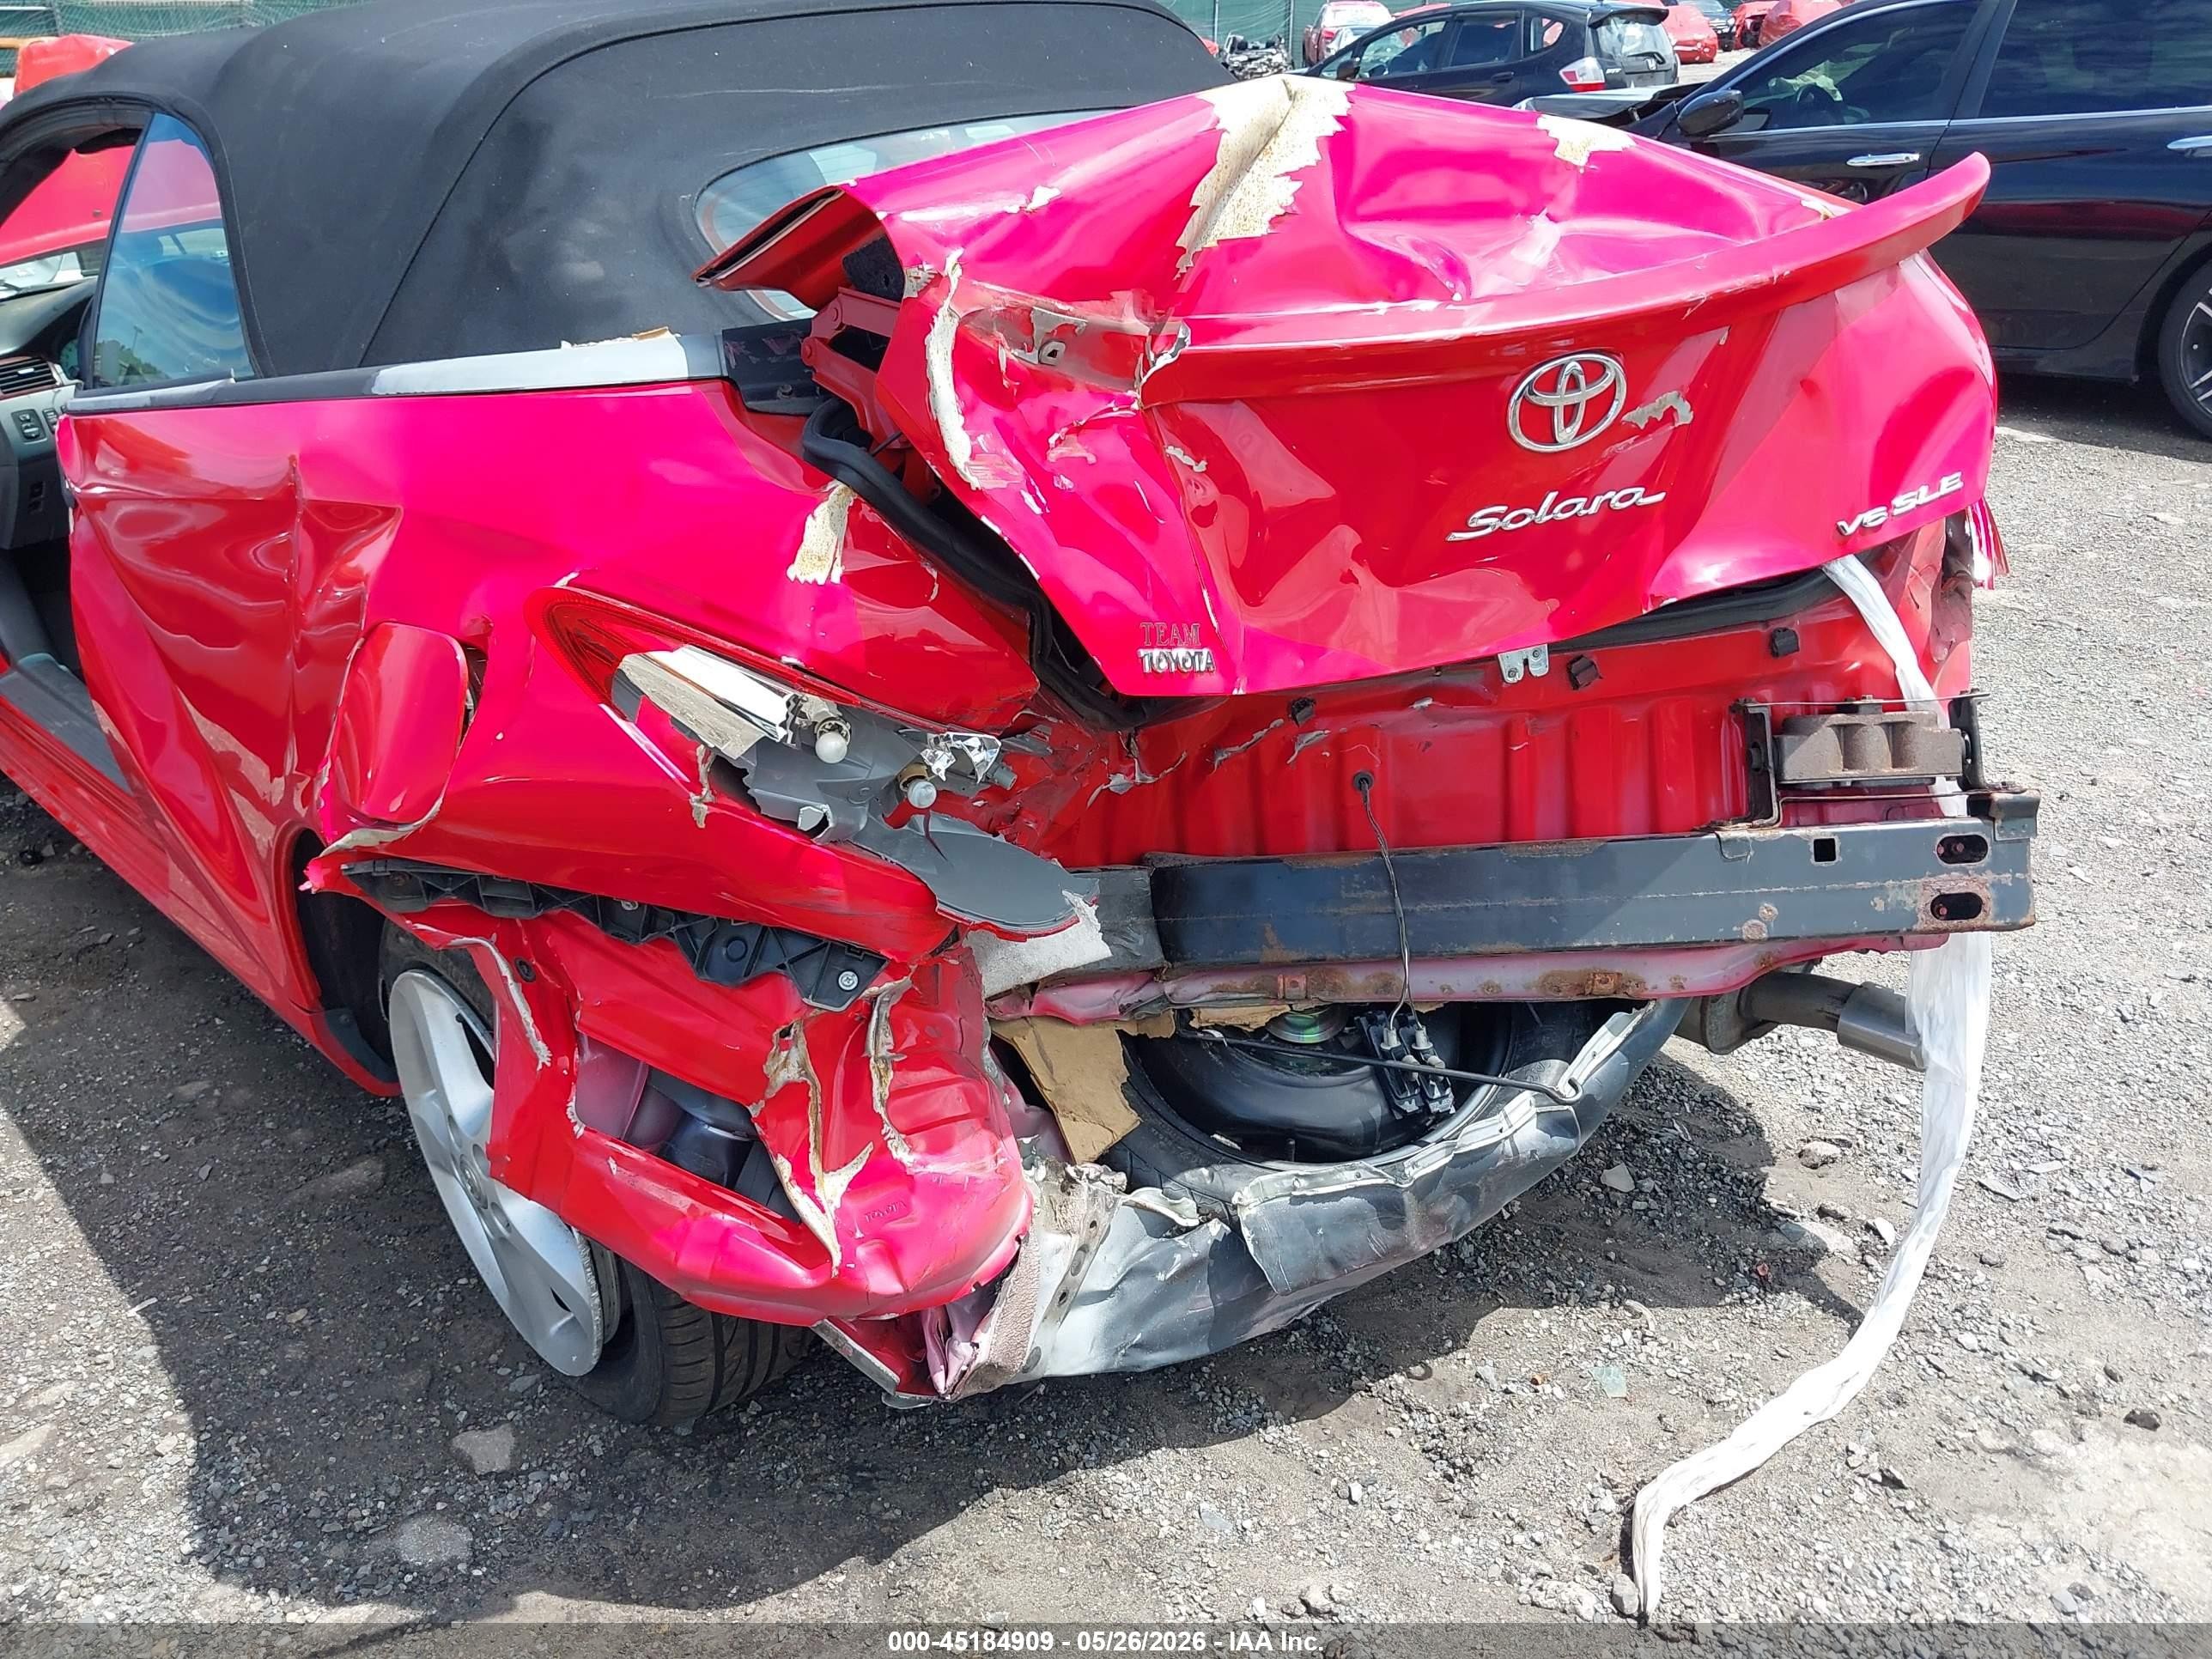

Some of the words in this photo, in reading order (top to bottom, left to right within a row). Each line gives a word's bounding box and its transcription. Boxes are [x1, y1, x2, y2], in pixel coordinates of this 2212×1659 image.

[1445, 486, 1666, 542] Solara
[1836, 505, 1888, 536] V6
[1891, 471, 1965, 516] SLE
[1139, 622, 1201, 646] TEAM
[1137, 647, 1216, 673] TOYOTA
